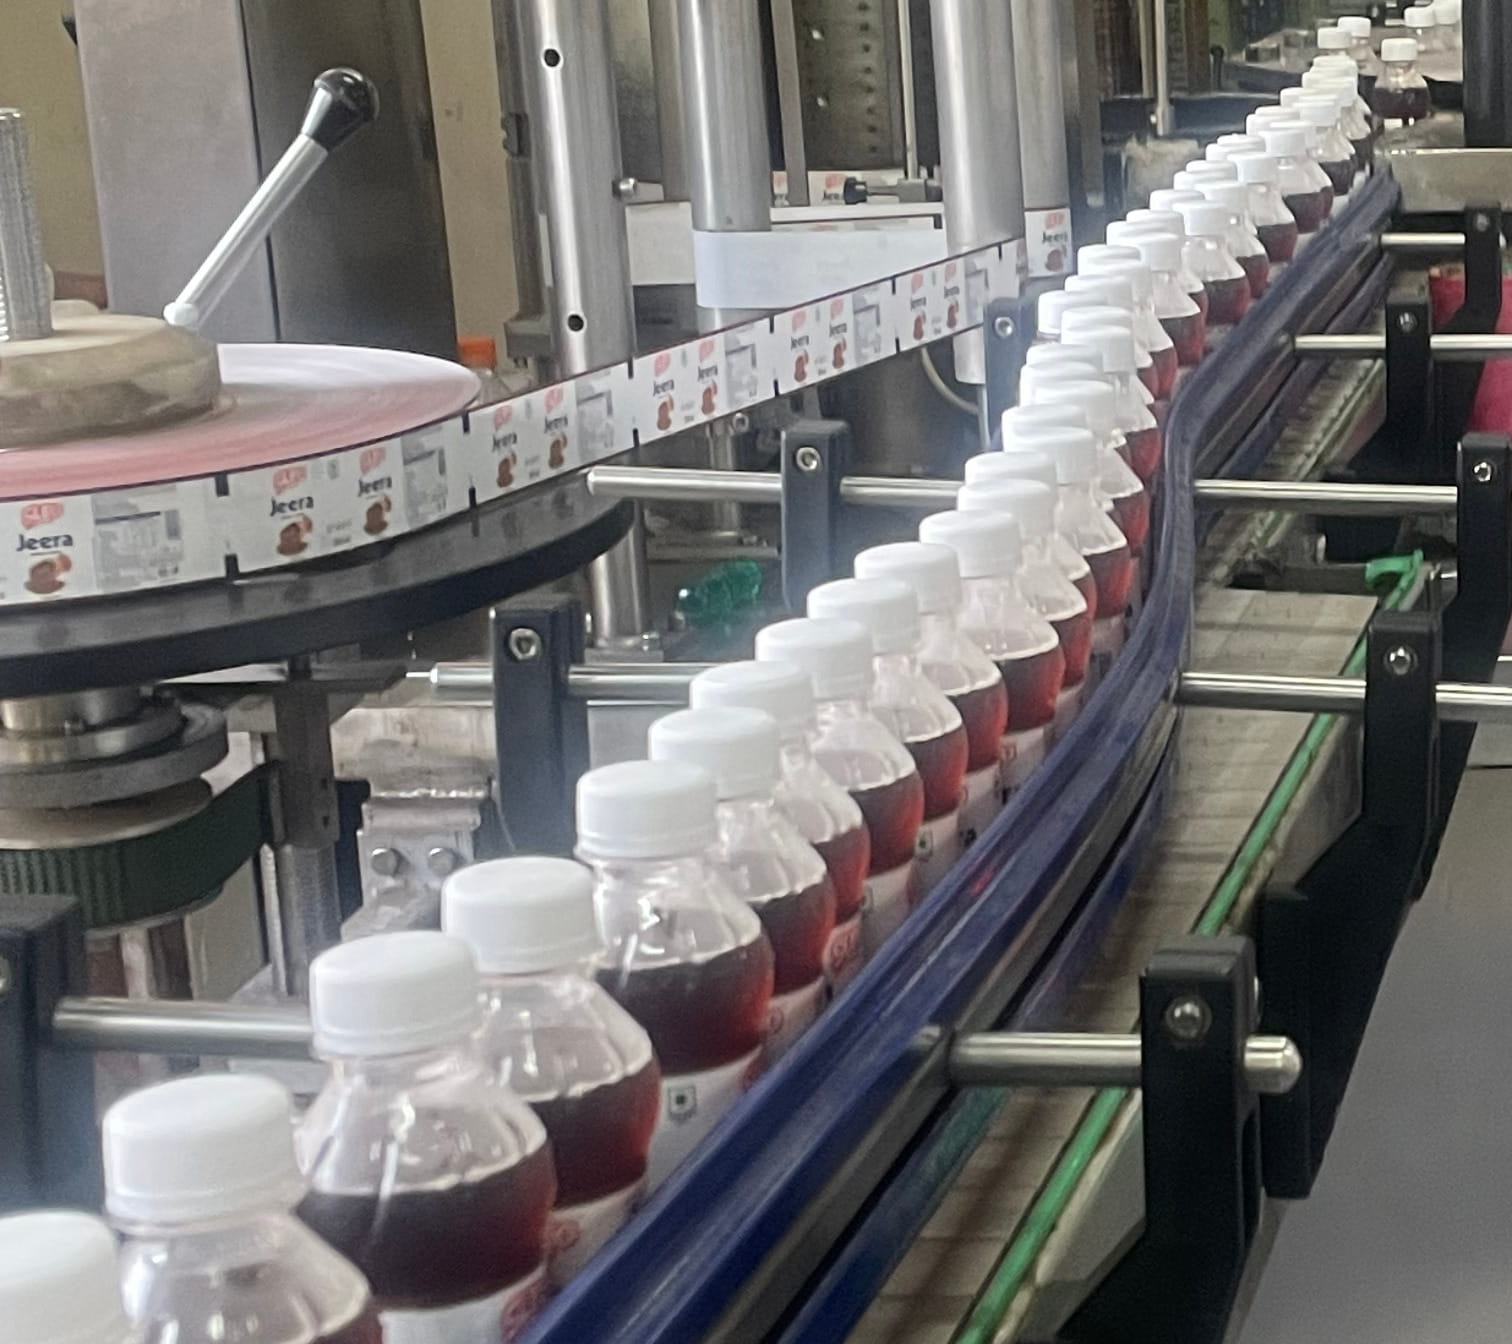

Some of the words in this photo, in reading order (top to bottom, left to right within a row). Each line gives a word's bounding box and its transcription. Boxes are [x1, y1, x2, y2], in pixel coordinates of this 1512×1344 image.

[357, 476, 393, 497] Jeera
[270, 495, 315, 517] Jeera
[16, 533, 74, 552] Jeera
